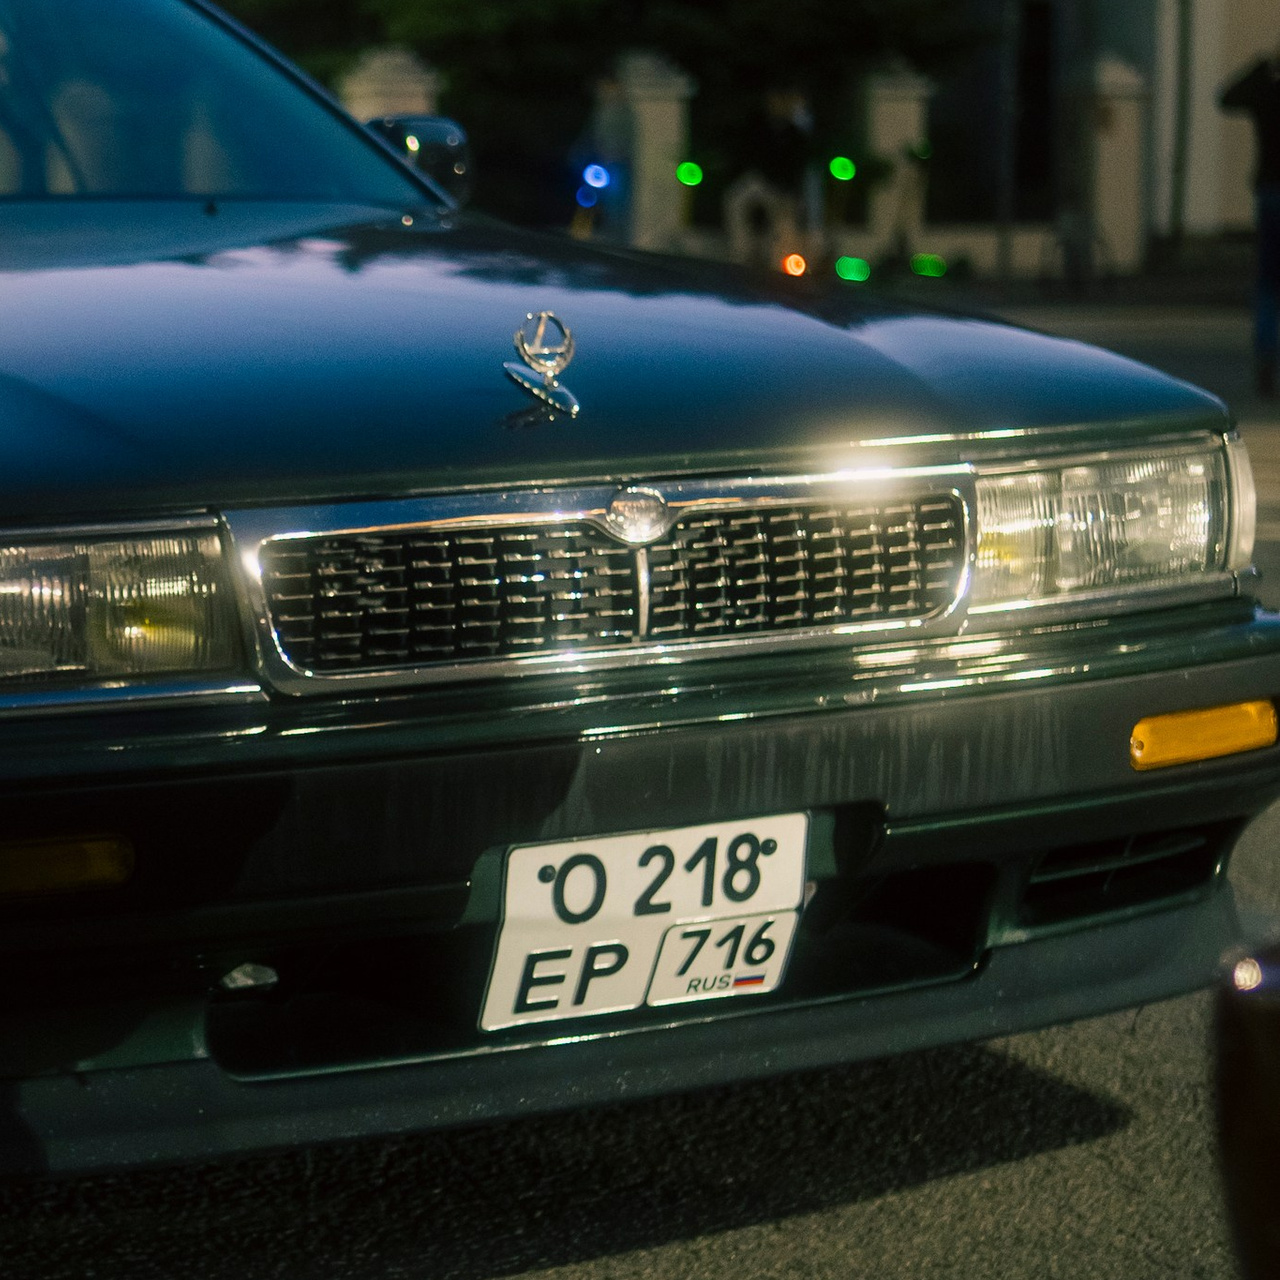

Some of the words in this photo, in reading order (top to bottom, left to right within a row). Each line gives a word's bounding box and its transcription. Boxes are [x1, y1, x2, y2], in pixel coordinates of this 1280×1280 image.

[634, 833, 761, 916] 218
[677, 920, 775, 977] 716
[686, 974, 732, 994] RUS
